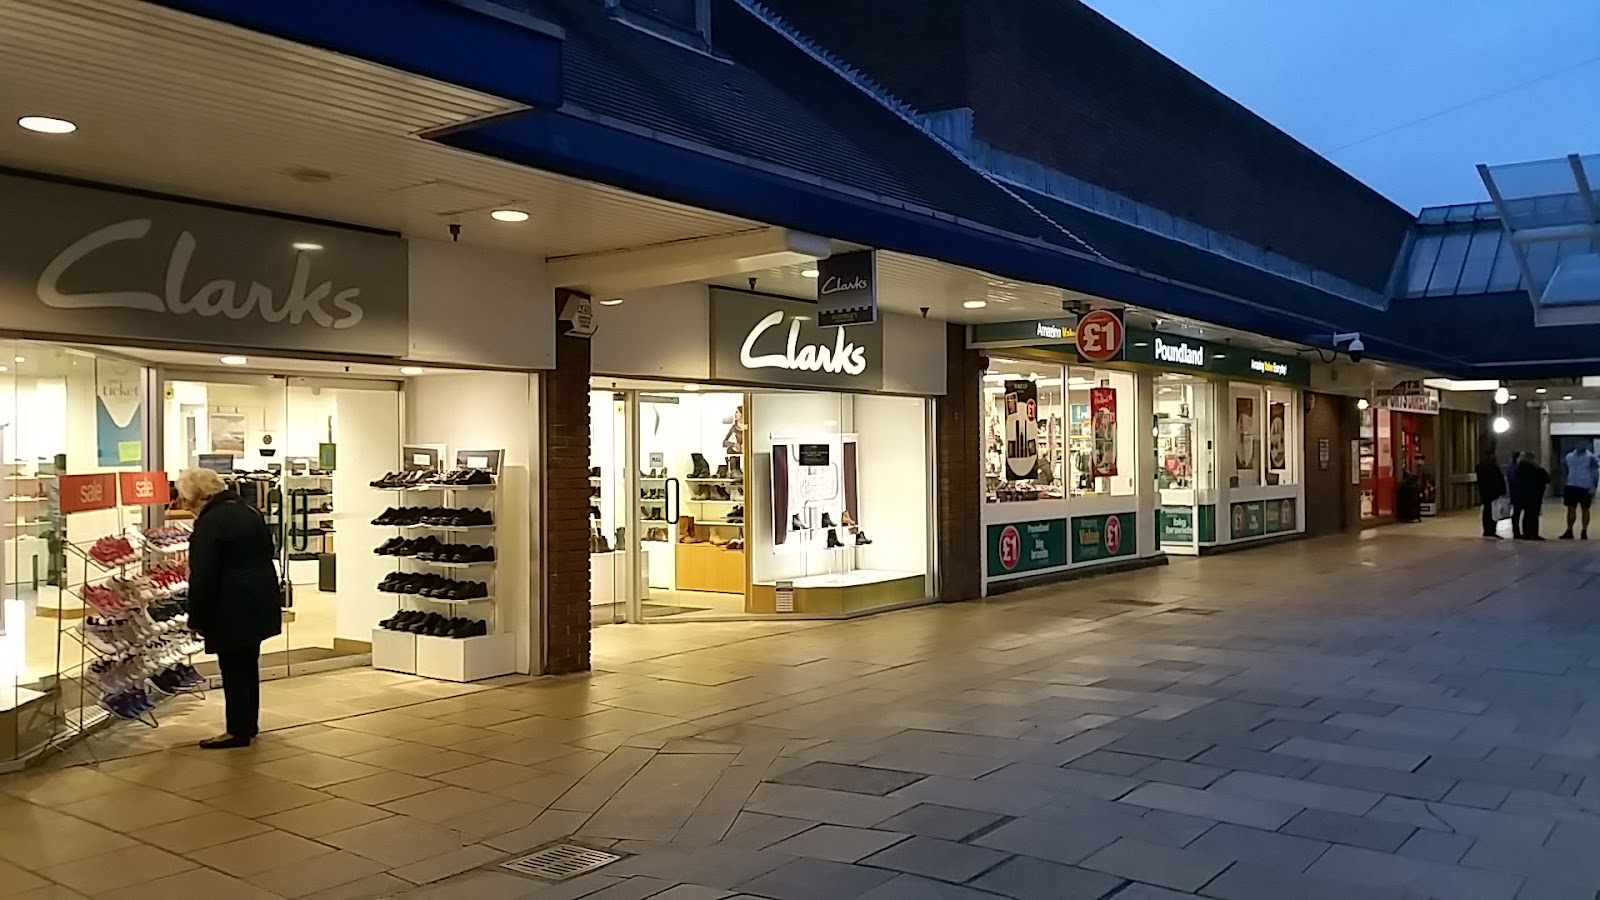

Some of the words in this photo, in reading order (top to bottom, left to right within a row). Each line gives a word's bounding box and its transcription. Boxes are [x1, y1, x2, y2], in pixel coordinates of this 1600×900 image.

[36, 218, 364, 329] Clarks
[821, 275, 868, 295] Clarks
[740, 310, 867, 375] Clarks
[1082, 321, 1115, 352] £1
[1155, 338, 1204, 366] Poundland
[80, 480, 103, 503] sale
[135, 476, 154, 498] sale
[1173, 518, 1187, 527] big
[1002, 534, 1017, 562] £1
[1105, 524, 1119, 547] £1
